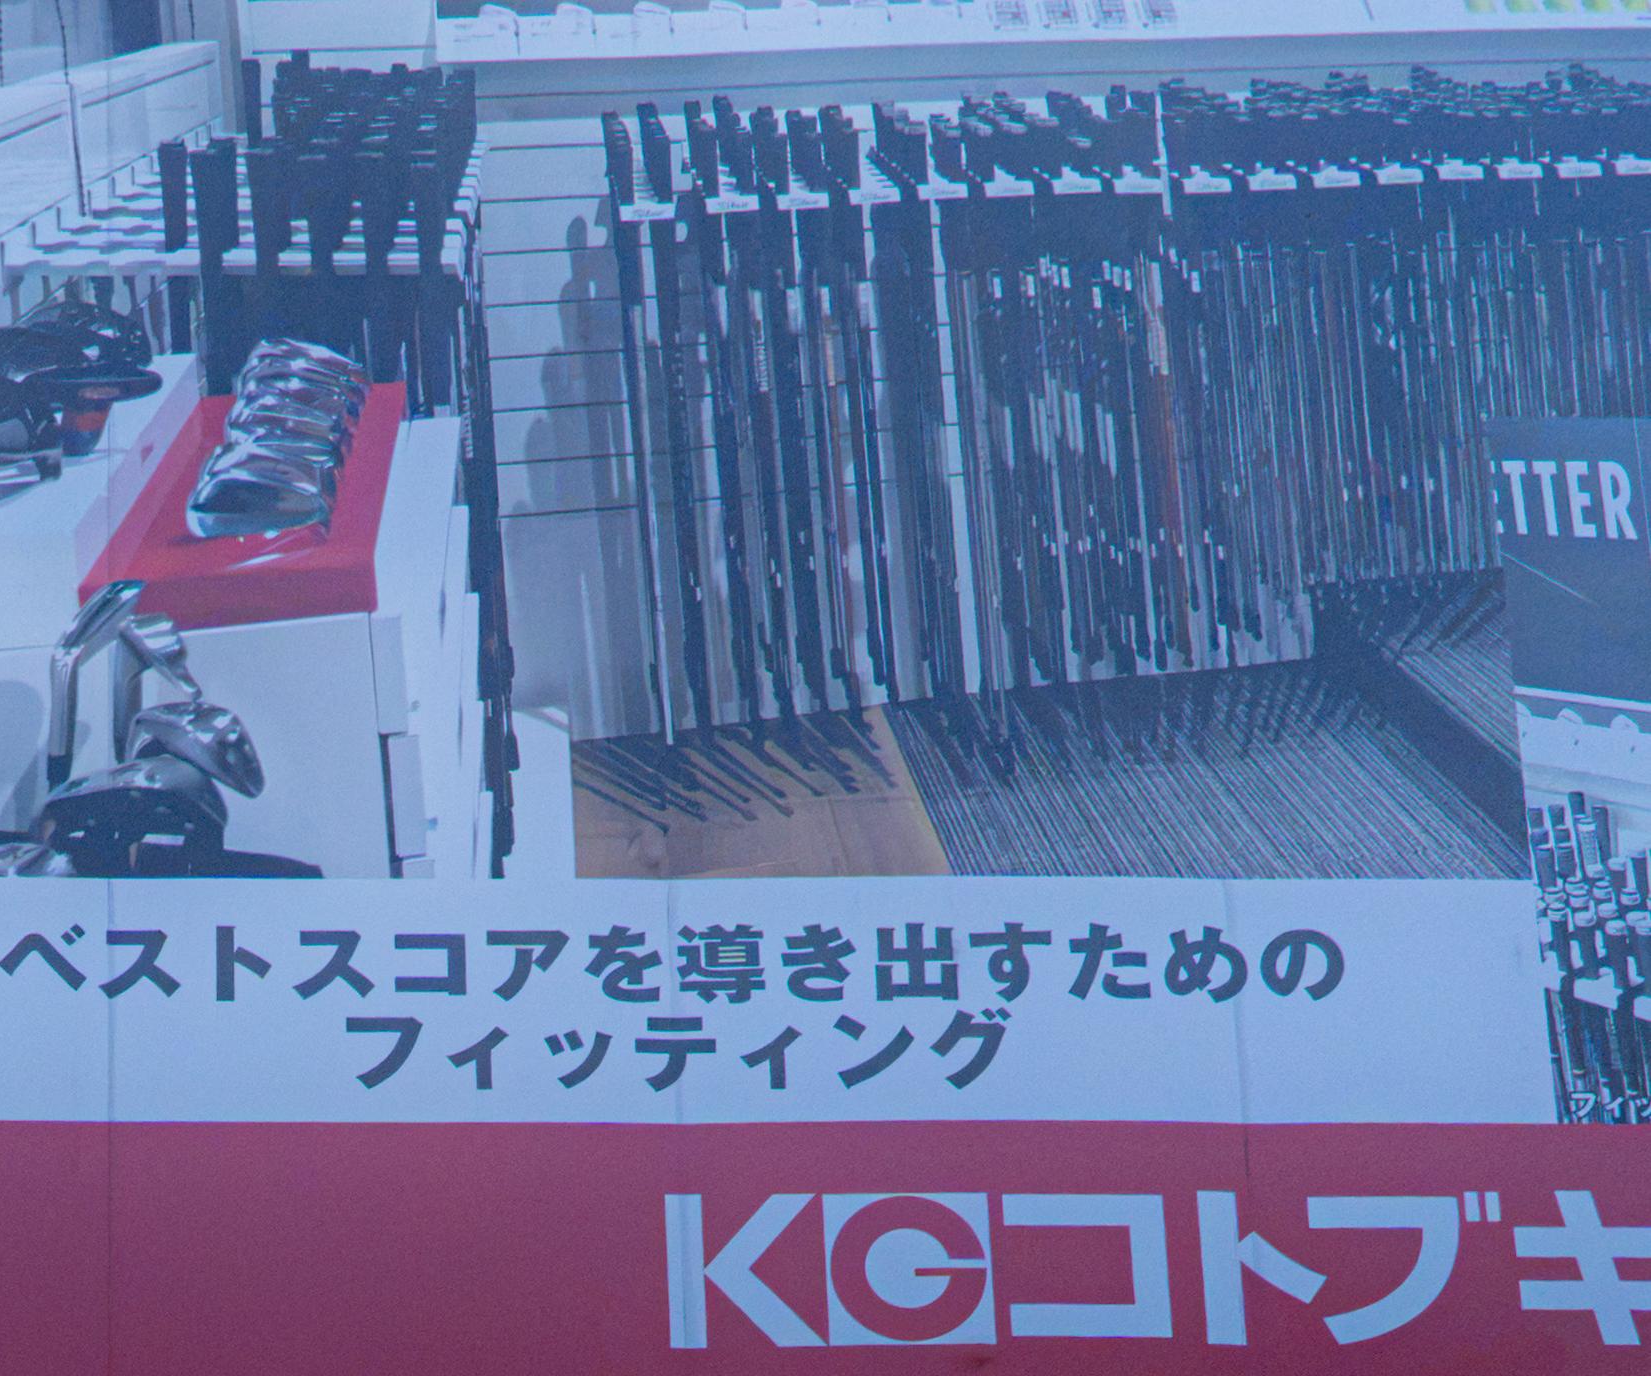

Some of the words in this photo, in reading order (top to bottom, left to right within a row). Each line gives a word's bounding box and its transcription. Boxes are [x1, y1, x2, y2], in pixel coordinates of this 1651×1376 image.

[1493, 460, 1637, 540] TTER
[343, 1011, 1013, 1094] フィッティング
